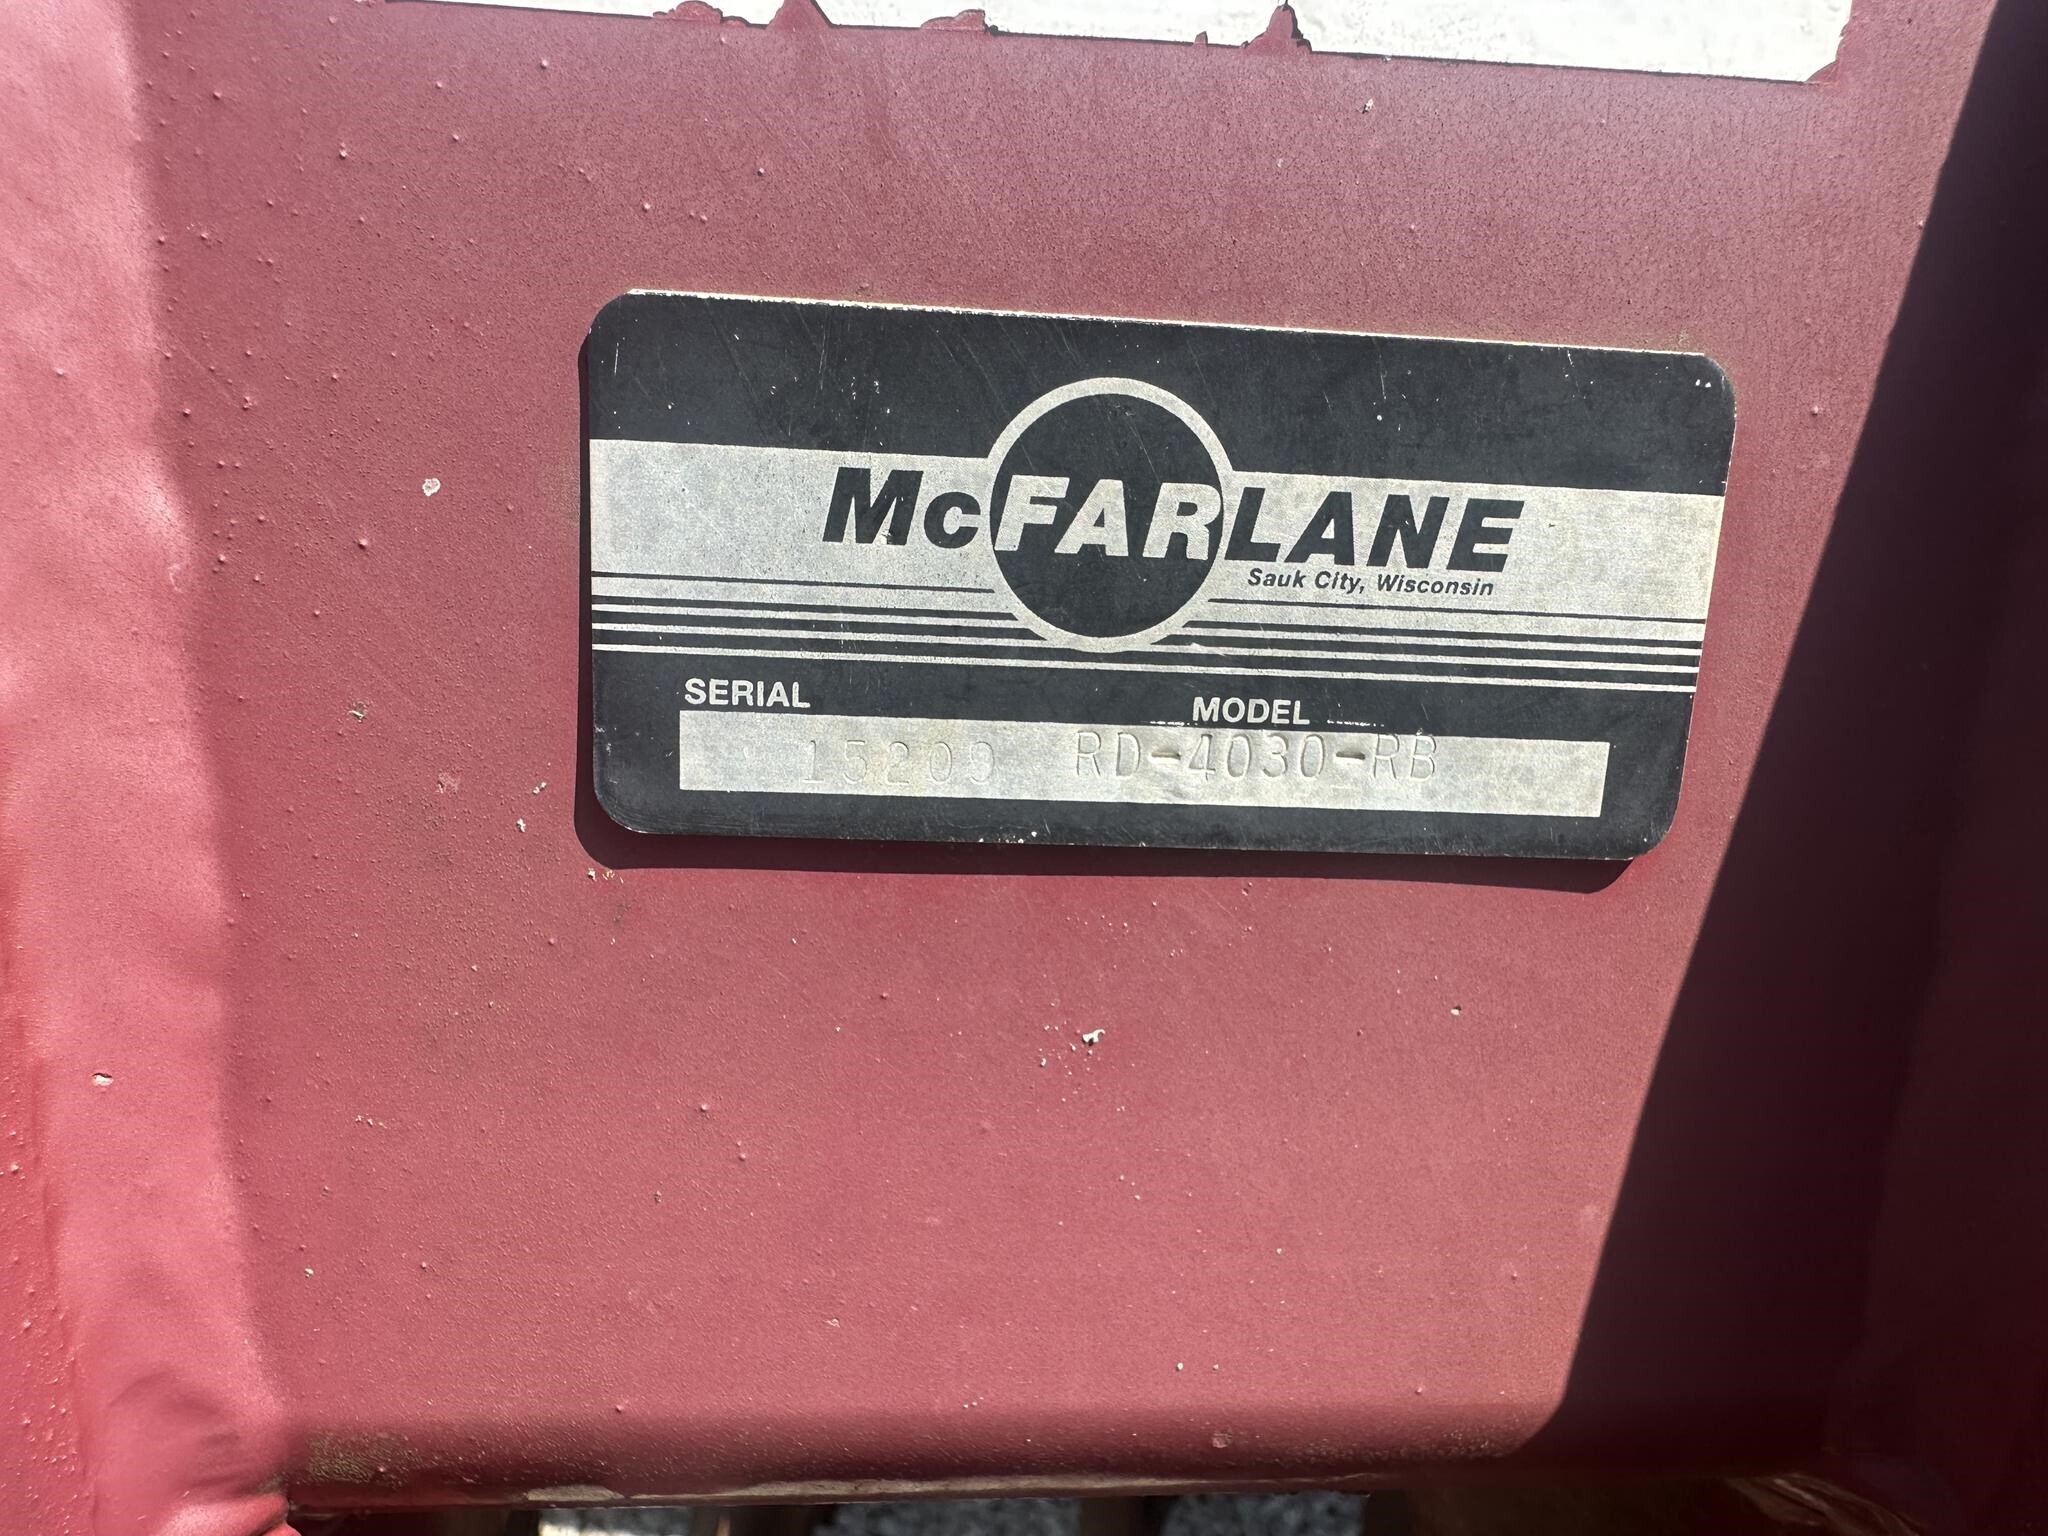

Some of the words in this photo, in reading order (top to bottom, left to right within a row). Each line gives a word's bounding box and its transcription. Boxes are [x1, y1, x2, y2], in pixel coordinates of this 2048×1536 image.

[823, 465, 1525, 572] McFARLANE
[1247, 567, 1307, 588] Sauk
[1314, 570, 1366, 594] City,
[1378, 573, 1494, 596] Wisconsin
[684, 679, 811, 709] SERIAL
[1192, 696, 1311, 725] MODEL
[1074, 730, 1439, 781] RD-4030-RB
